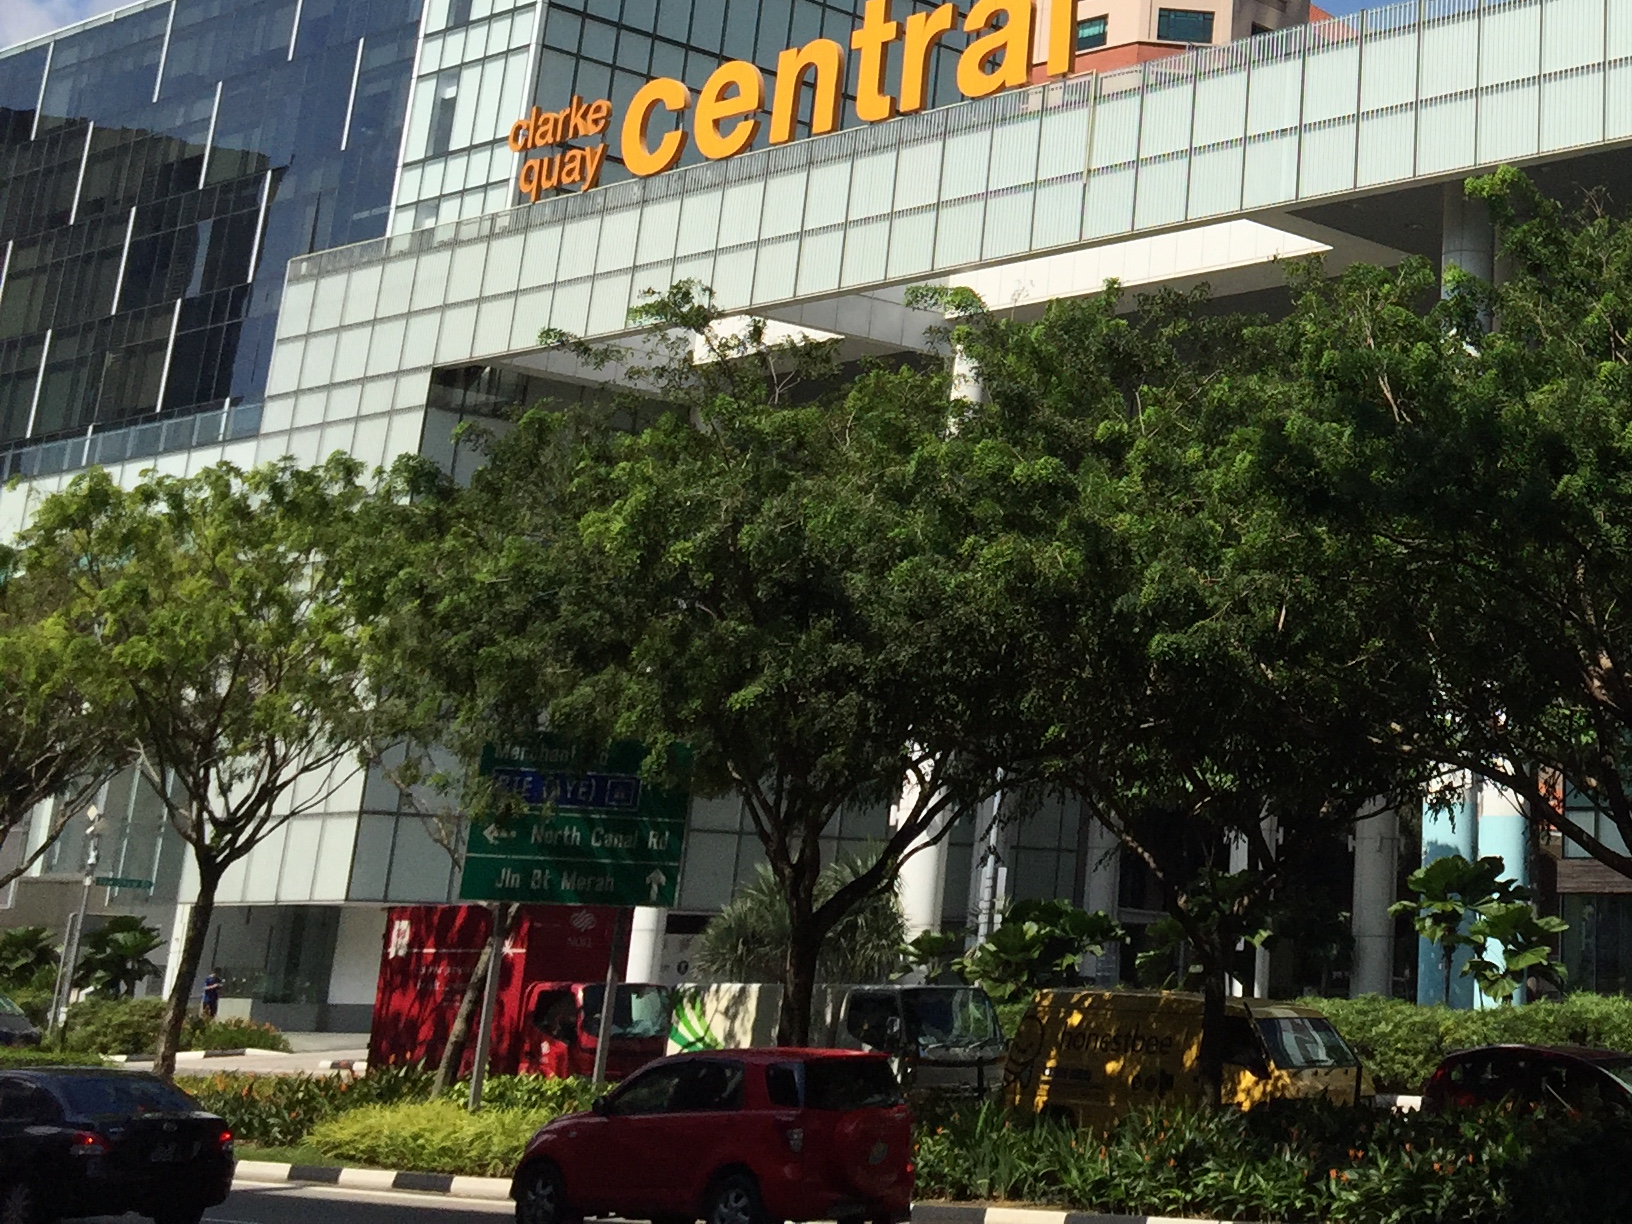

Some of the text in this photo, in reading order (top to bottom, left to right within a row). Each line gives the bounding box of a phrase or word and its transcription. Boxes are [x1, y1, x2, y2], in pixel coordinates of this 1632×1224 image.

[508, 95, 613, 153] clarke
[519, 143, 610, 204] quay
[530, 824, 670, 851] North Canal Rd
[495, 867, 521, 889] Jln
[560, 869, 615, 892] Merah
[1061, 1022, 1174, 1056] honestbee
